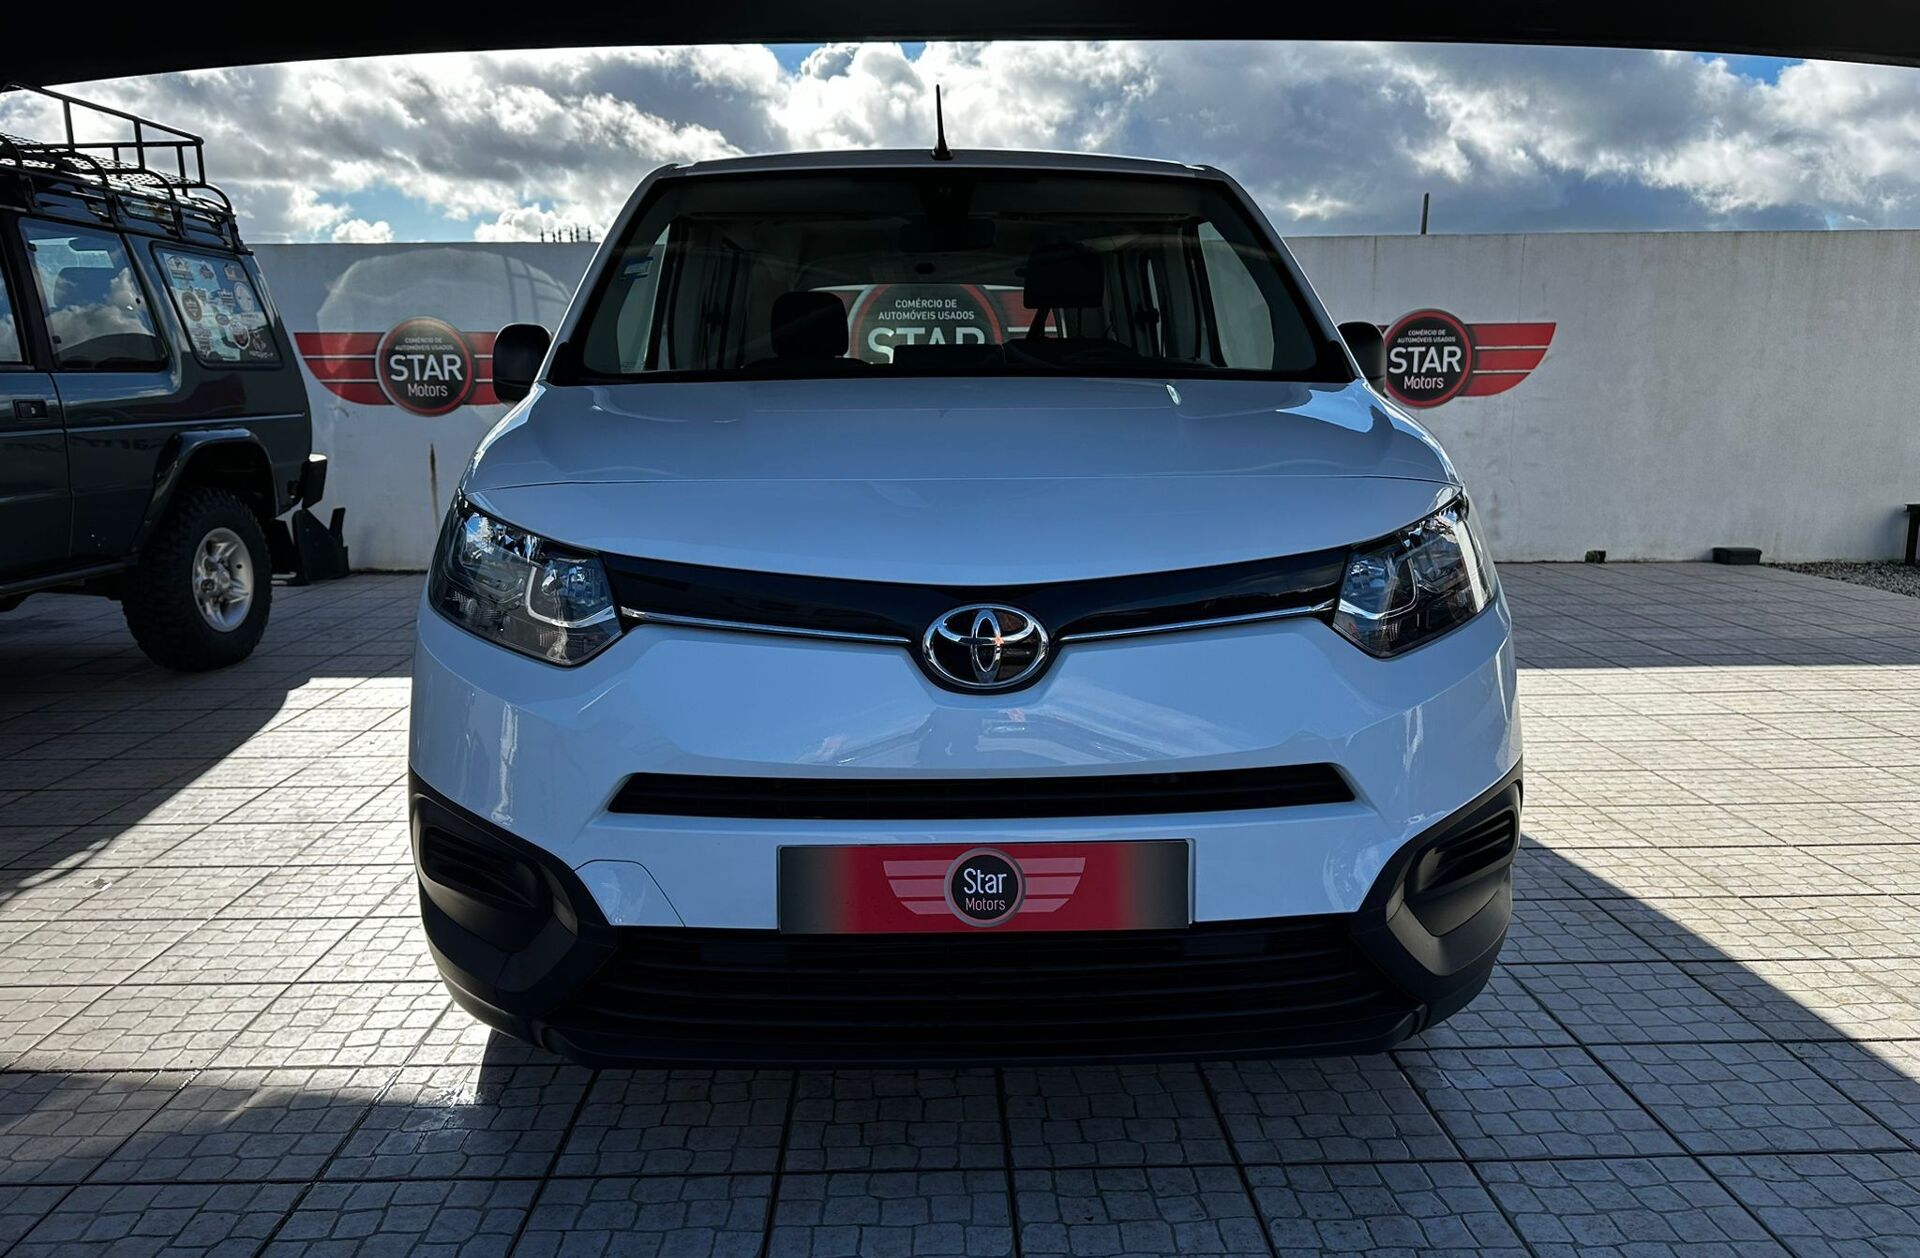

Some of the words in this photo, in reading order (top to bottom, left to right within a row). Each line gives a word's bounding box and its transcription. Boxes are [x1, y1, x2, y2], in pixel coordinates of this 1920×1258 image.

[895, 297, 943, 308] COMÉRCIO
[945, 299, 958, 308] DE
[878, 310, 936, 320] AUTOMÓVEIS
[937, 311, 975, 320] USADOS
[1388, 346, 1462, 373] STAR
[389, 354, 463, 381] STAR
[407, 382, 448, 397] Motors
[1403, 375, 1444, 390] Motors
[963, 868, 1007, 894] Star
[965, 897, 1006, 911] Motors
